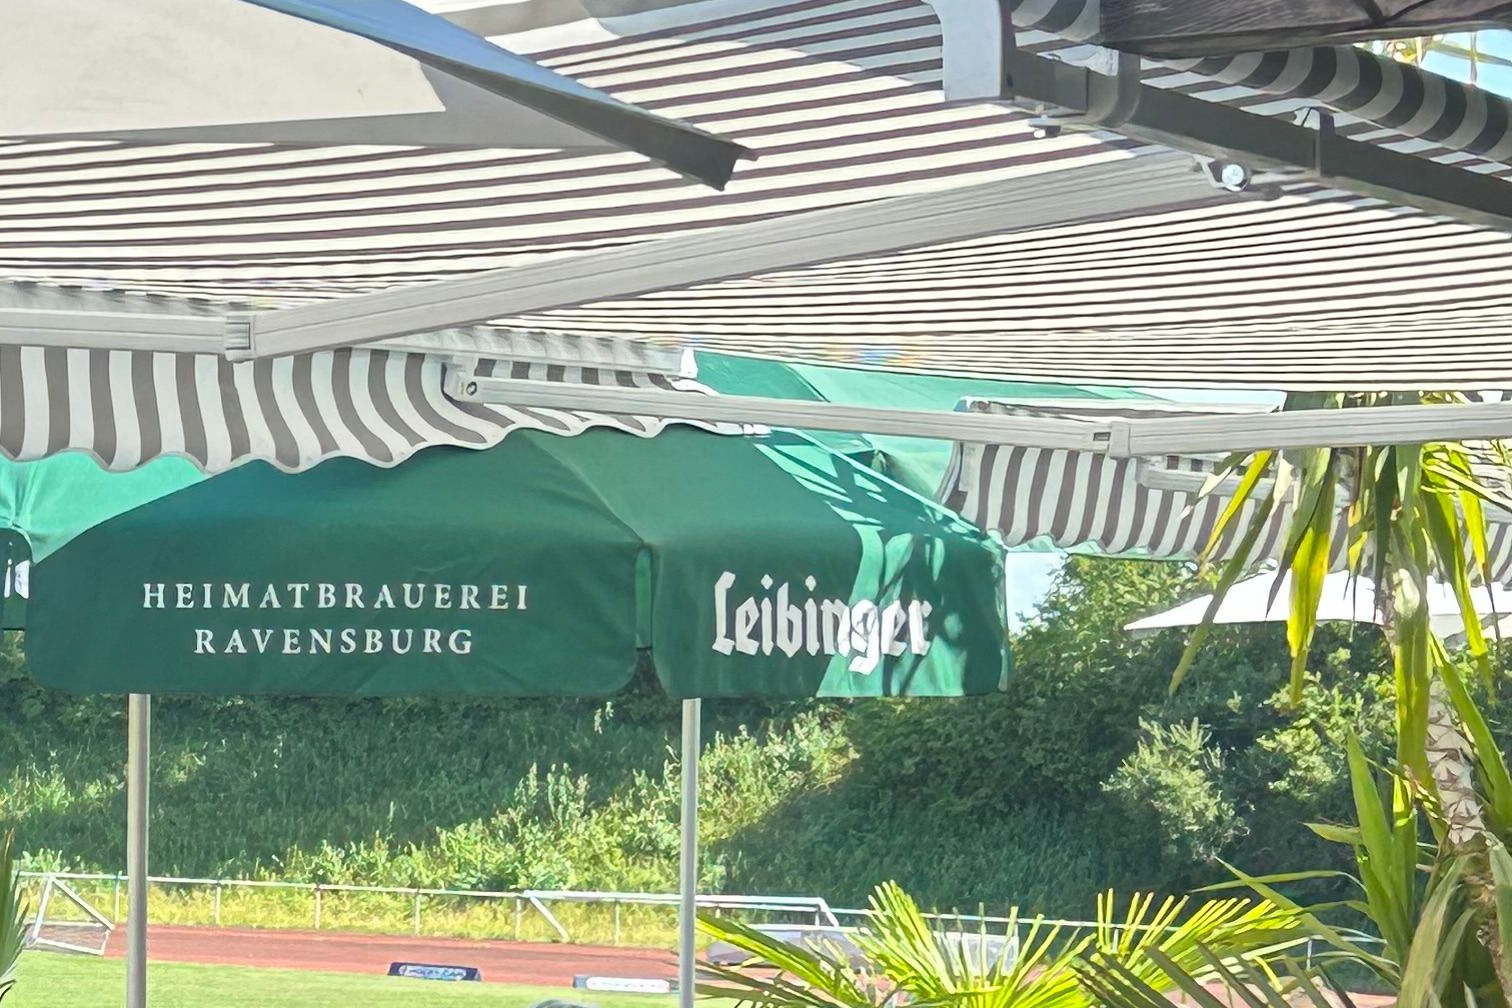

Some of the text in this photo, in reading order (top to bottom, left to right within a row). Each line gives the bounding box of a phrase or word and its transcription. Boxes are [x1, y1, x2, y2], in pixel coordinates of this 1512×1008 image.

[142, 583, 528, 611] HEIMATBRAUEREI
[711, 571, 933, 675] Leibinger
[194, 628, 472, 655] RAVENSBURG
